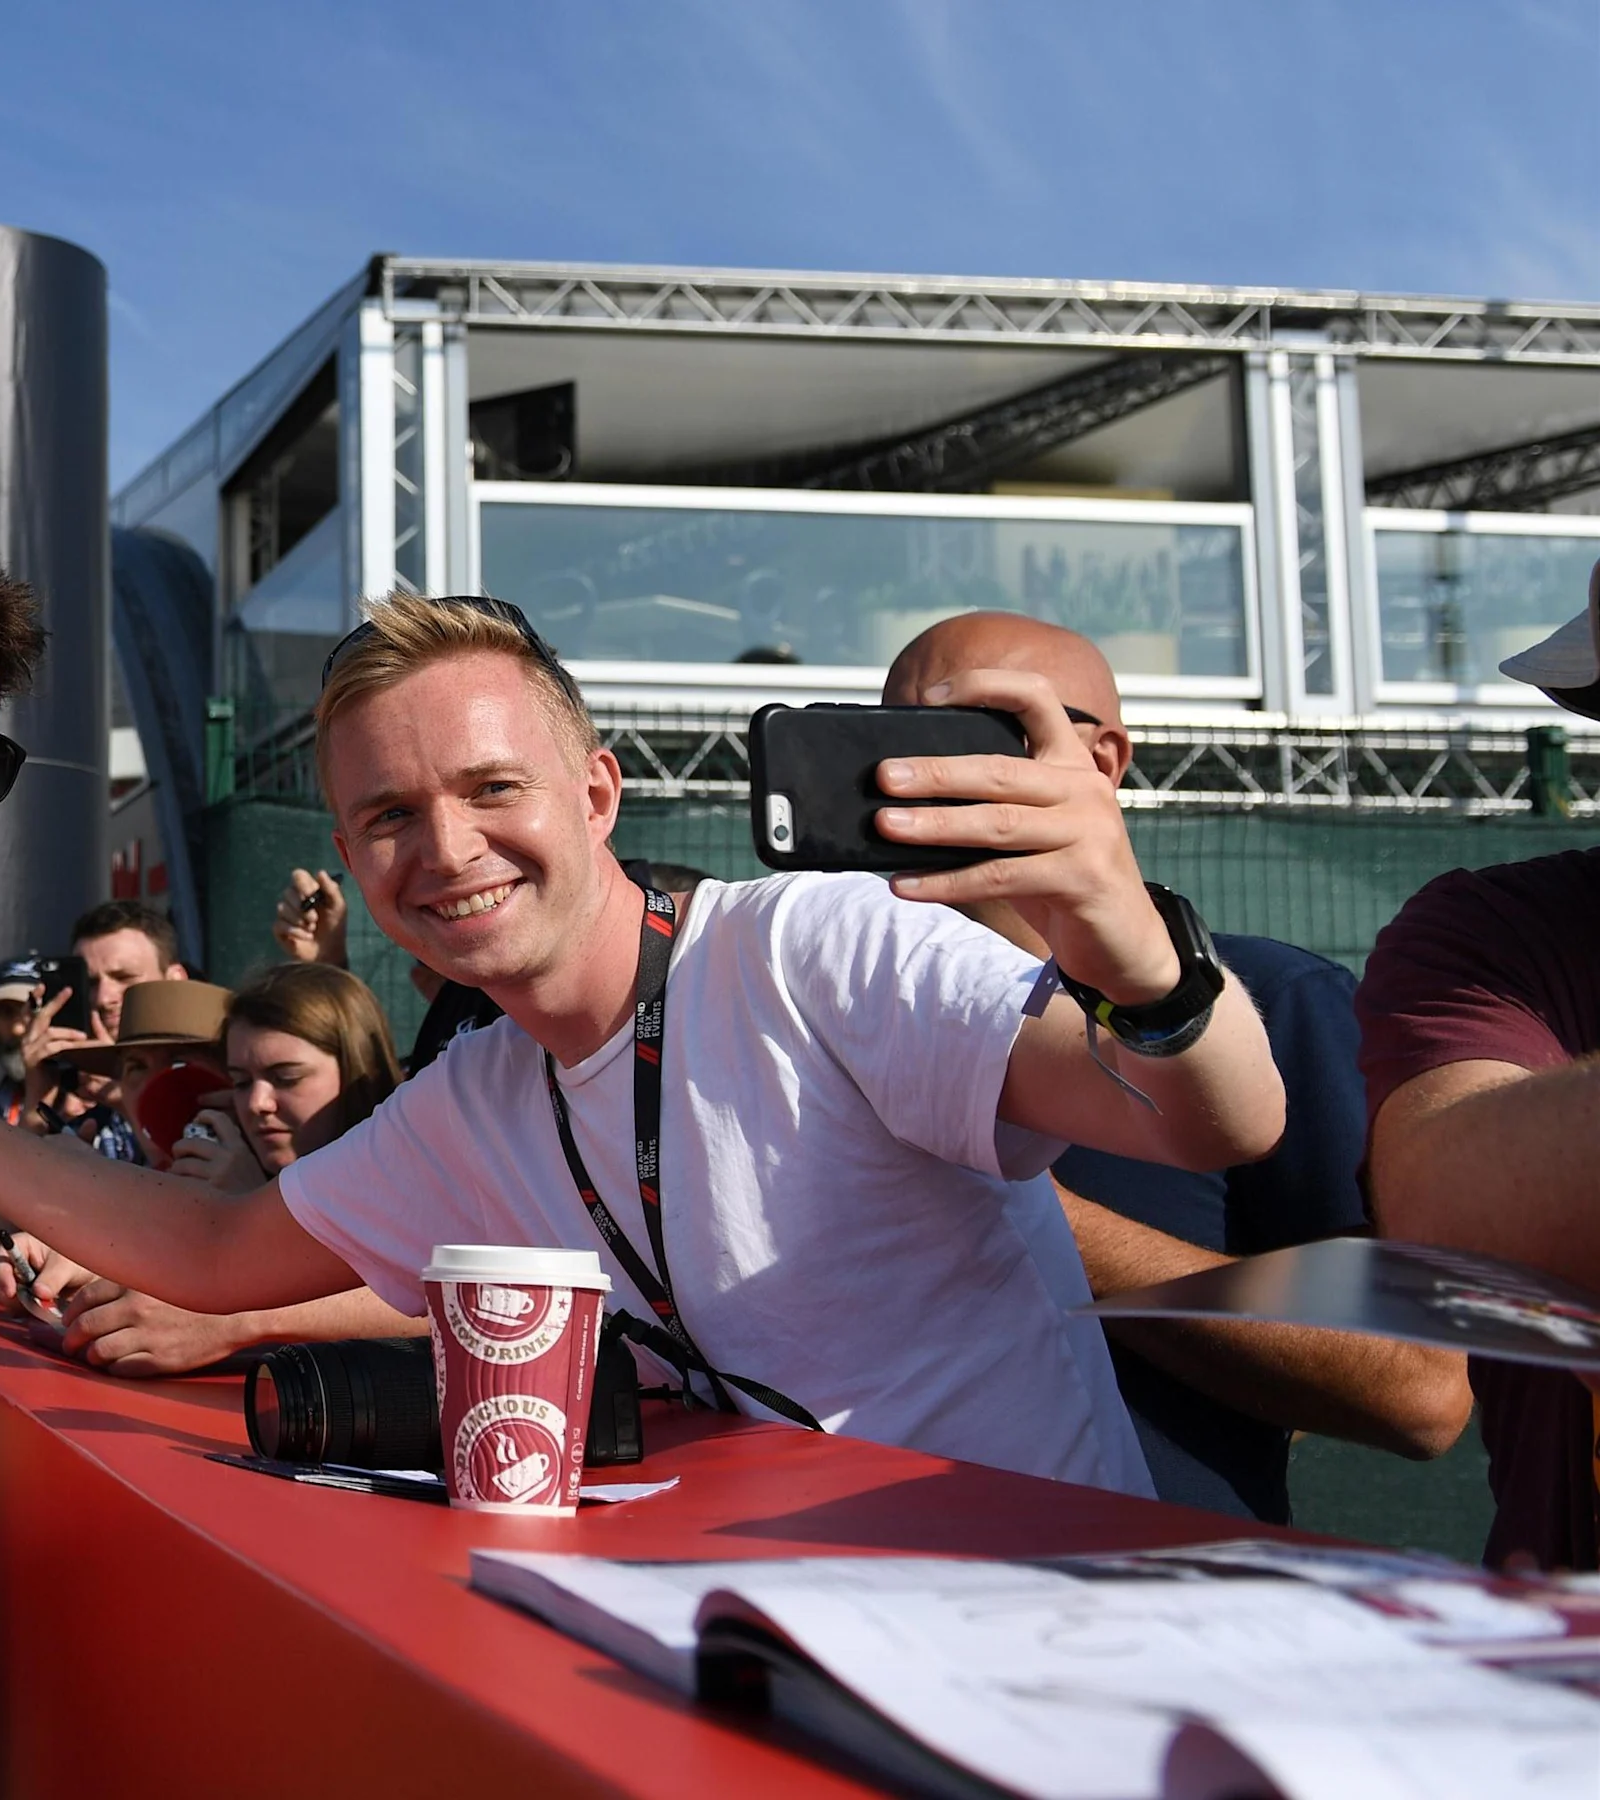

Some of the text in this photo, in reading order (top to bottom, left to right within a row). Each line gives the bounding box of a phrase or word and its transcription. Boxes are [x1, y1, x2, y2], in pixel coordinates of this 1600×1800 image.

[636, 1002, 646, 1039] GRAND
[644, 1015, 653, 1038] PRIX
[652, 1001, 661, 1037] EVENTS
[649, 1139, 657, 1177] EVENTS
[450, 1312, 551, 1361] HOT DRINK
[456, 1399, 549, 1470] DELICIOUS
